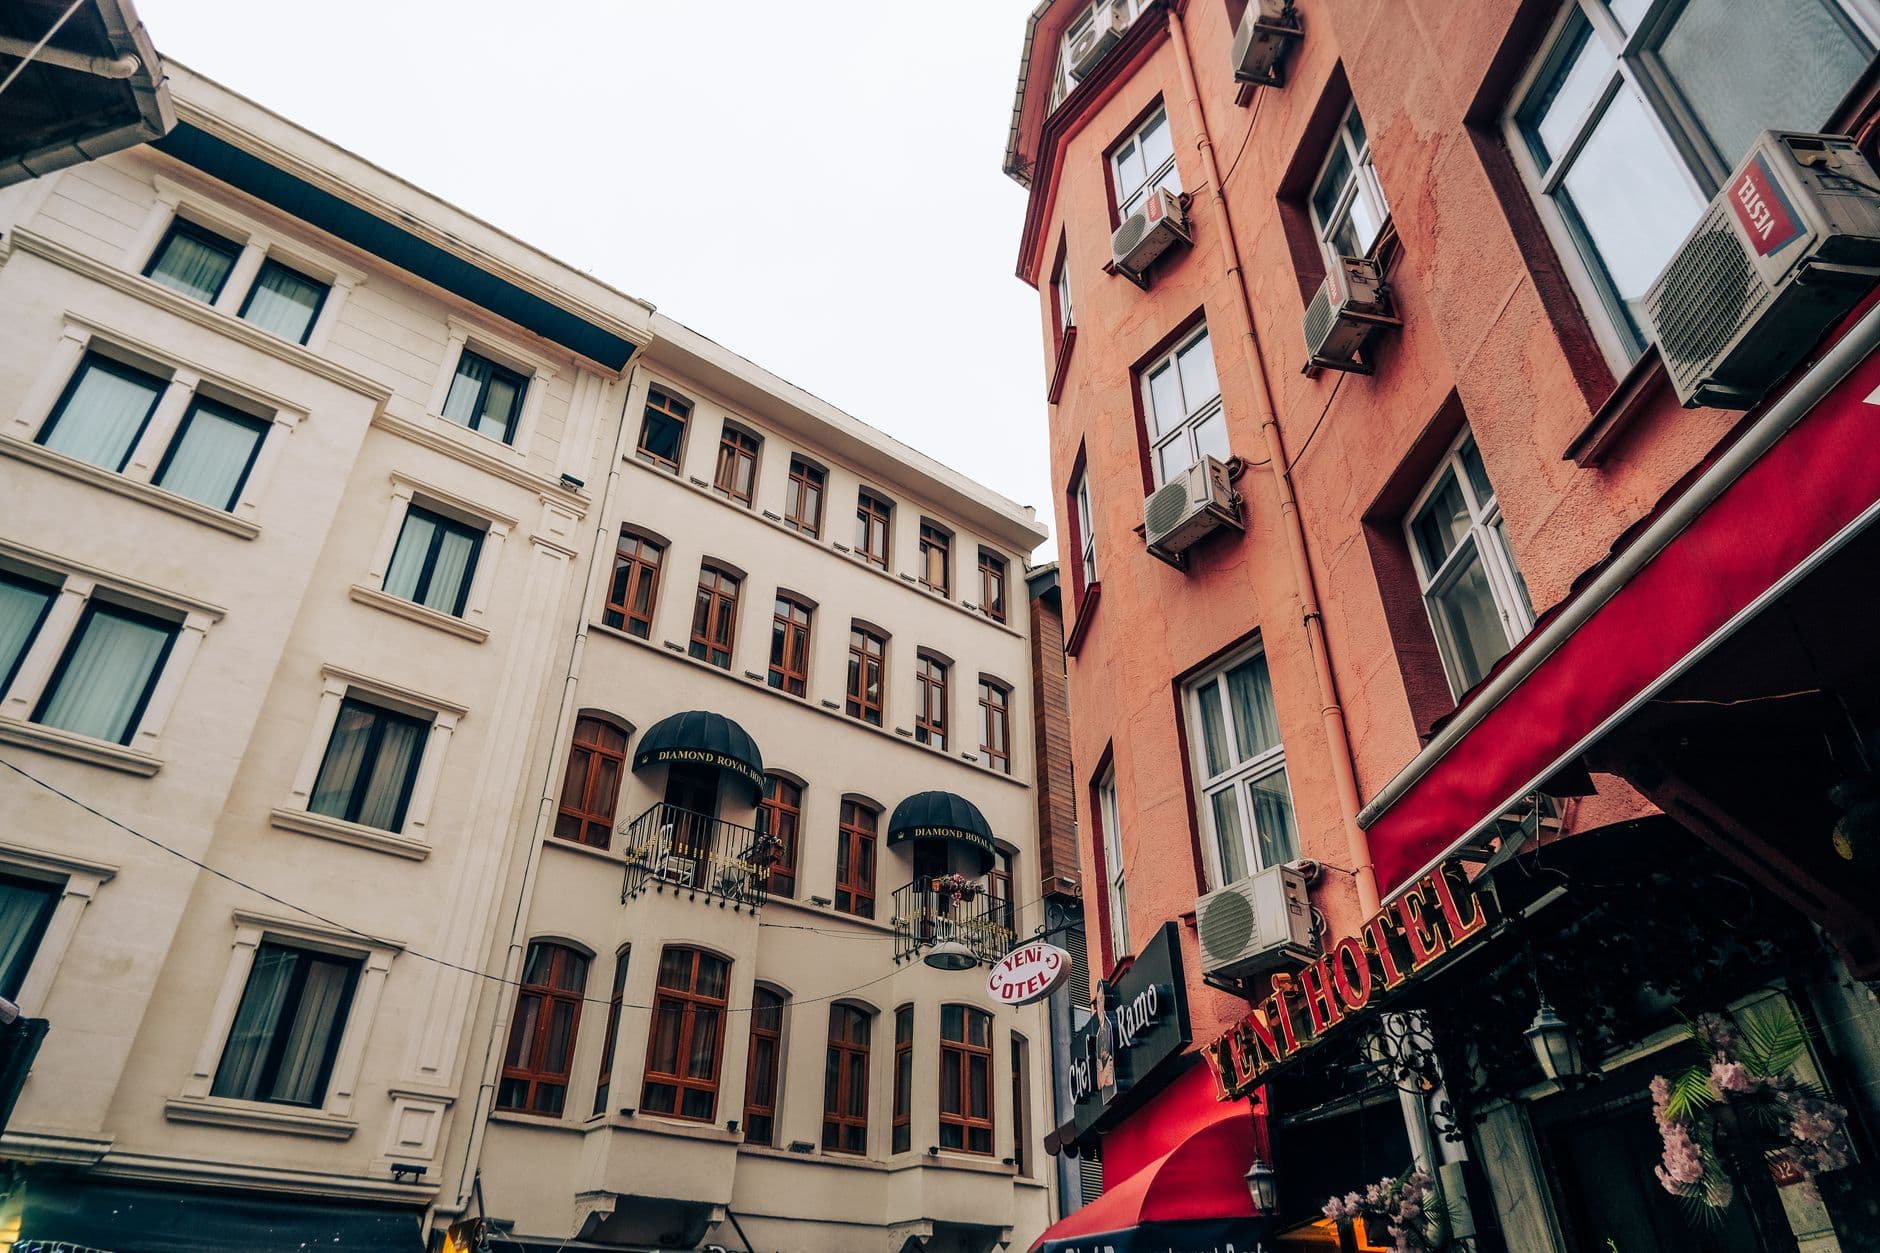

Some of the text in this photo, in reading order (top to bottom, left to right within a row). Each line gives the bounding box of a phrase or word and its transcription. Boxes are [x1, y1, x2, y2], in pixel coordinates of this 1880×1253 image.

[1738, 175, 1775, 240] VESTEL
[659, 751, 714, 762] DIAMOND
[717, 755, 748, 775] ROYAL
[915, 828, 963, 838] DIAMOND
[965, 832, 989, 849] ROYAL
[1299, 862, 1487, 1038] HOTEL
[1001, 971, 1051, 999] OTEL
[1069, 983, 1157, 1105] Chef Ramo
[1776, 1160, 1794, 1178] 12
